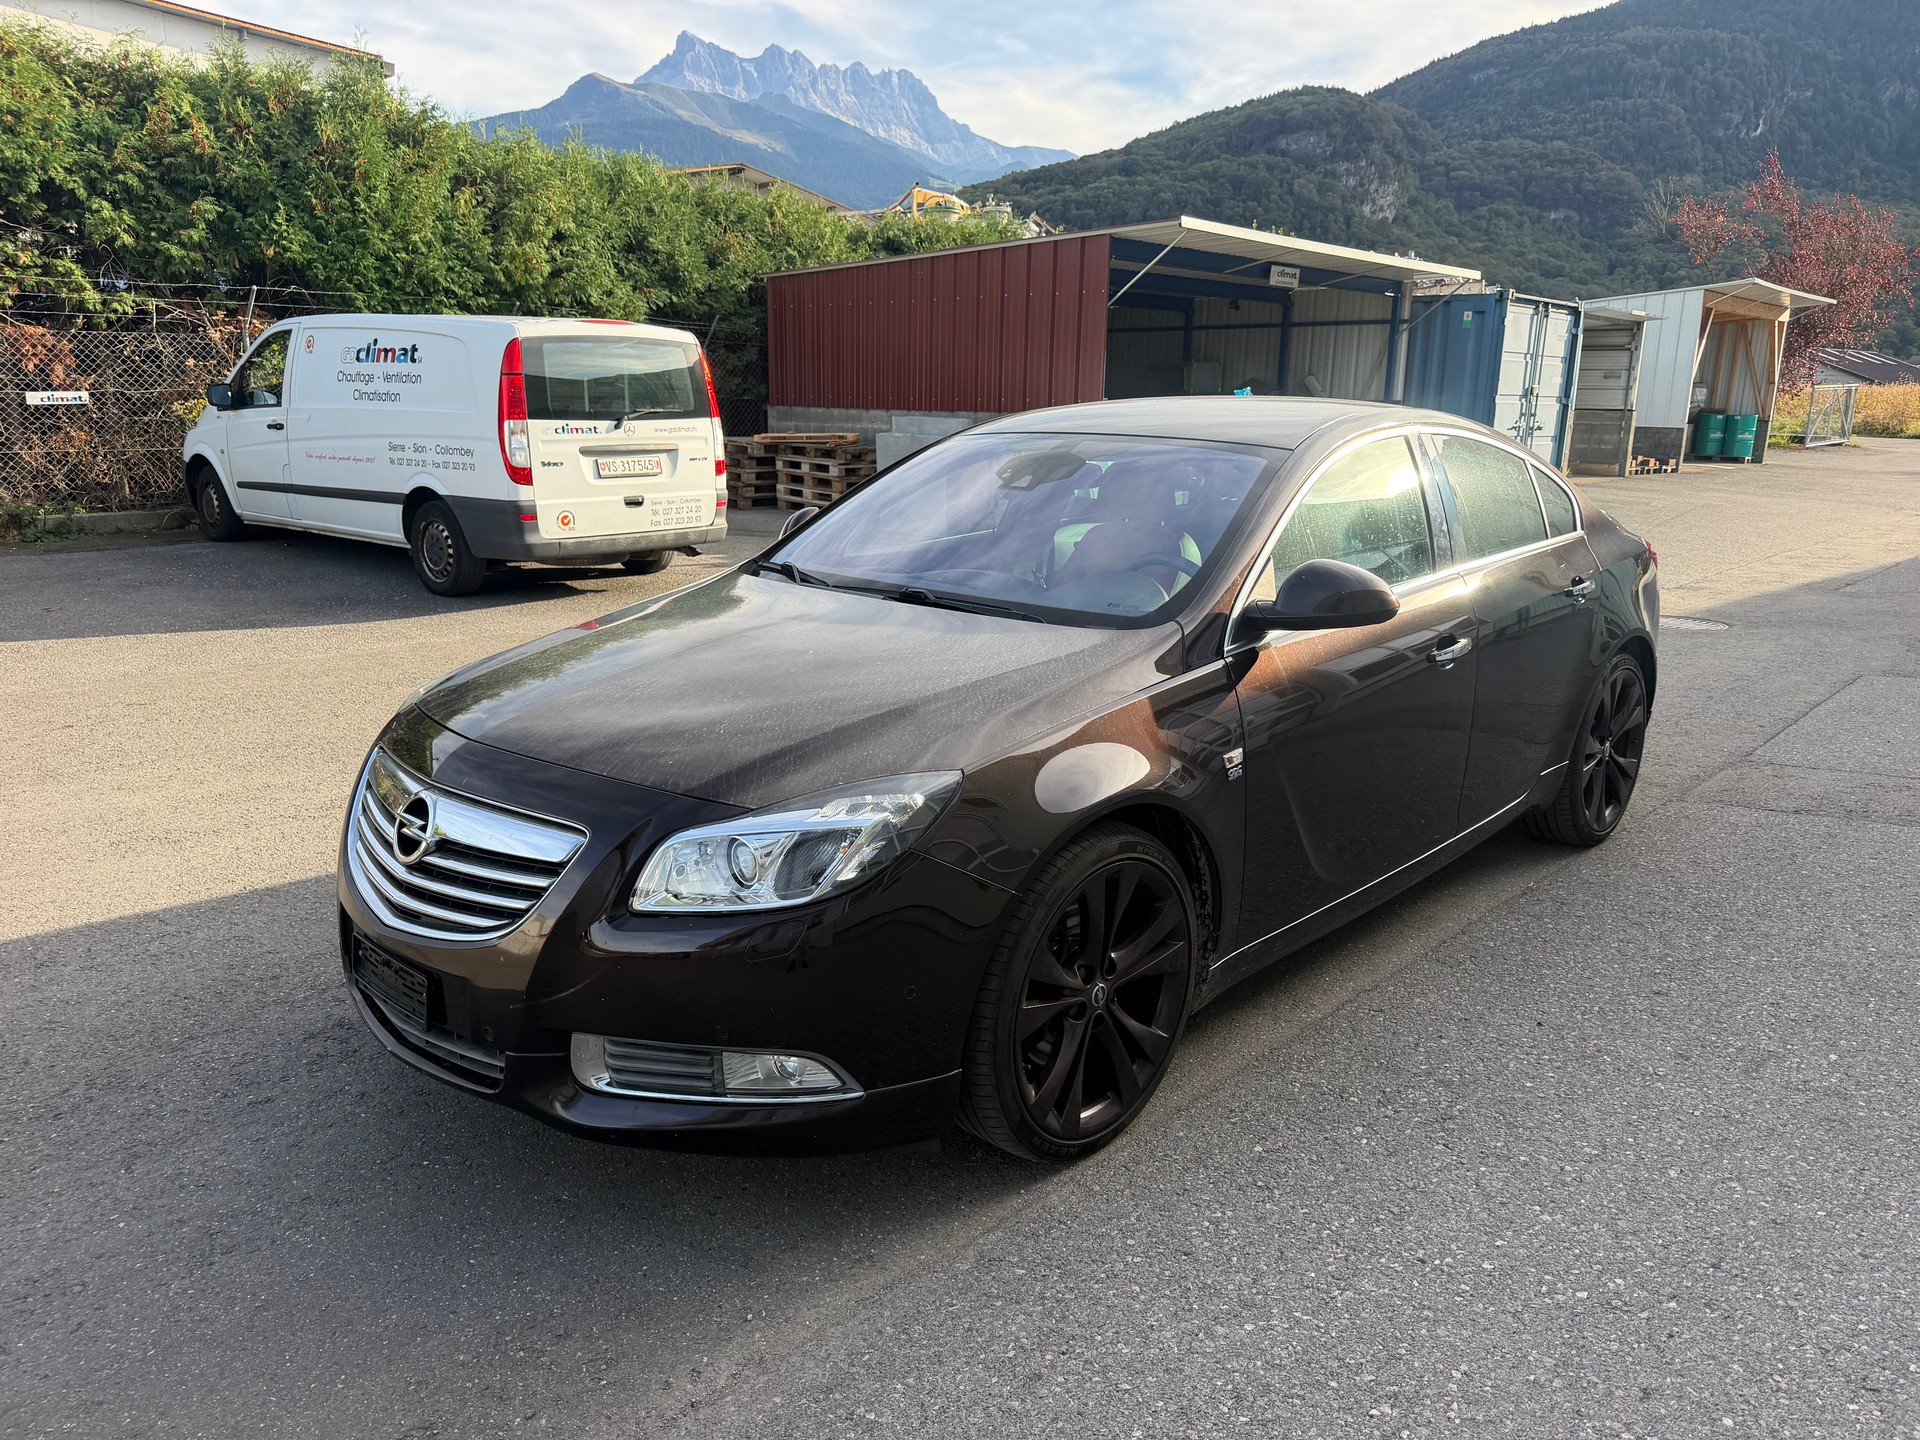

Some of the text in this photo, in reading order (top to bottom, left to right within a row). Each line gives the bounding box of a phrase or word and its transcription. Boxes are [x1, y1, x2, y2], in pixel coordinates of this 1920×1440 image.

[337, 371, 374, 386] Chauffage
[382, 371, 422, 384] Ventilation
[353, 389, 400, 402] Climatisation
[388, 441, 405, 452] Sierre
[412, 443, 427, 454] Sion
[435, 444, 475, 459] Collombey
[405, 458, 413, 467] 327
[414, 459, 420, 467] 24
[421, 459, 427, 468] 20
[432, 460, 440, 468] Fax
[442, 461, 450, 469] 027
[452, 462, 460, 470] 323
[461, 462, 468, 471] 20
[469, 463, 476, 471] 93
[605, 459, 655, 472] VS 317545
[663, 507, 673, 515] 027
[675, 506, 684, 514] 327
[695, 505, 702, 513] 20
[651, 515, 702, 527] Fax 027 323 20 93
